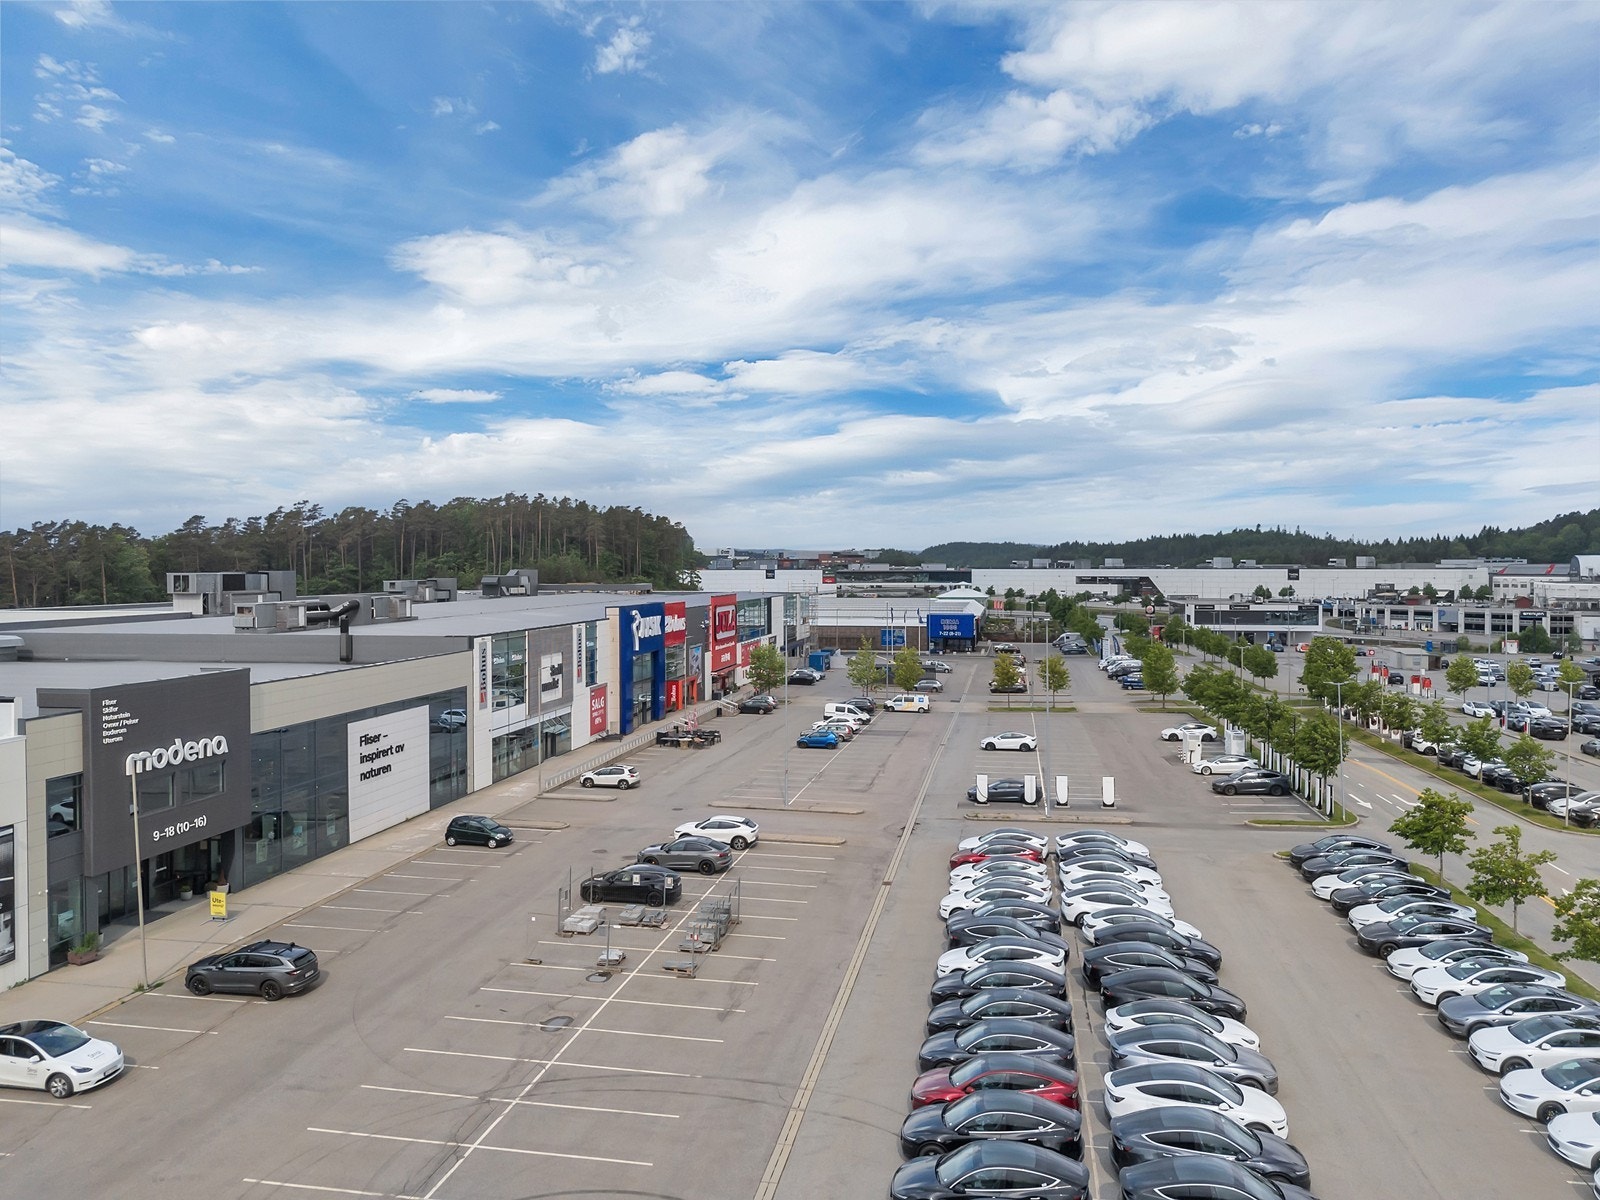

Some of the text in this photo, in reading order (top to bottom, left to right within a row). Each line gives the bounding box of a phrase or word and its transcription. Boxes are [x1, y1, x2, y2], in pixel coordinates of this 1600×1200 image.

[360, 733, 381, 747] Fliser
[125, 735, 229, 776] modena
[360, 743, 405, 764] inspirert av
[360, 764, 392, 781] naturen
